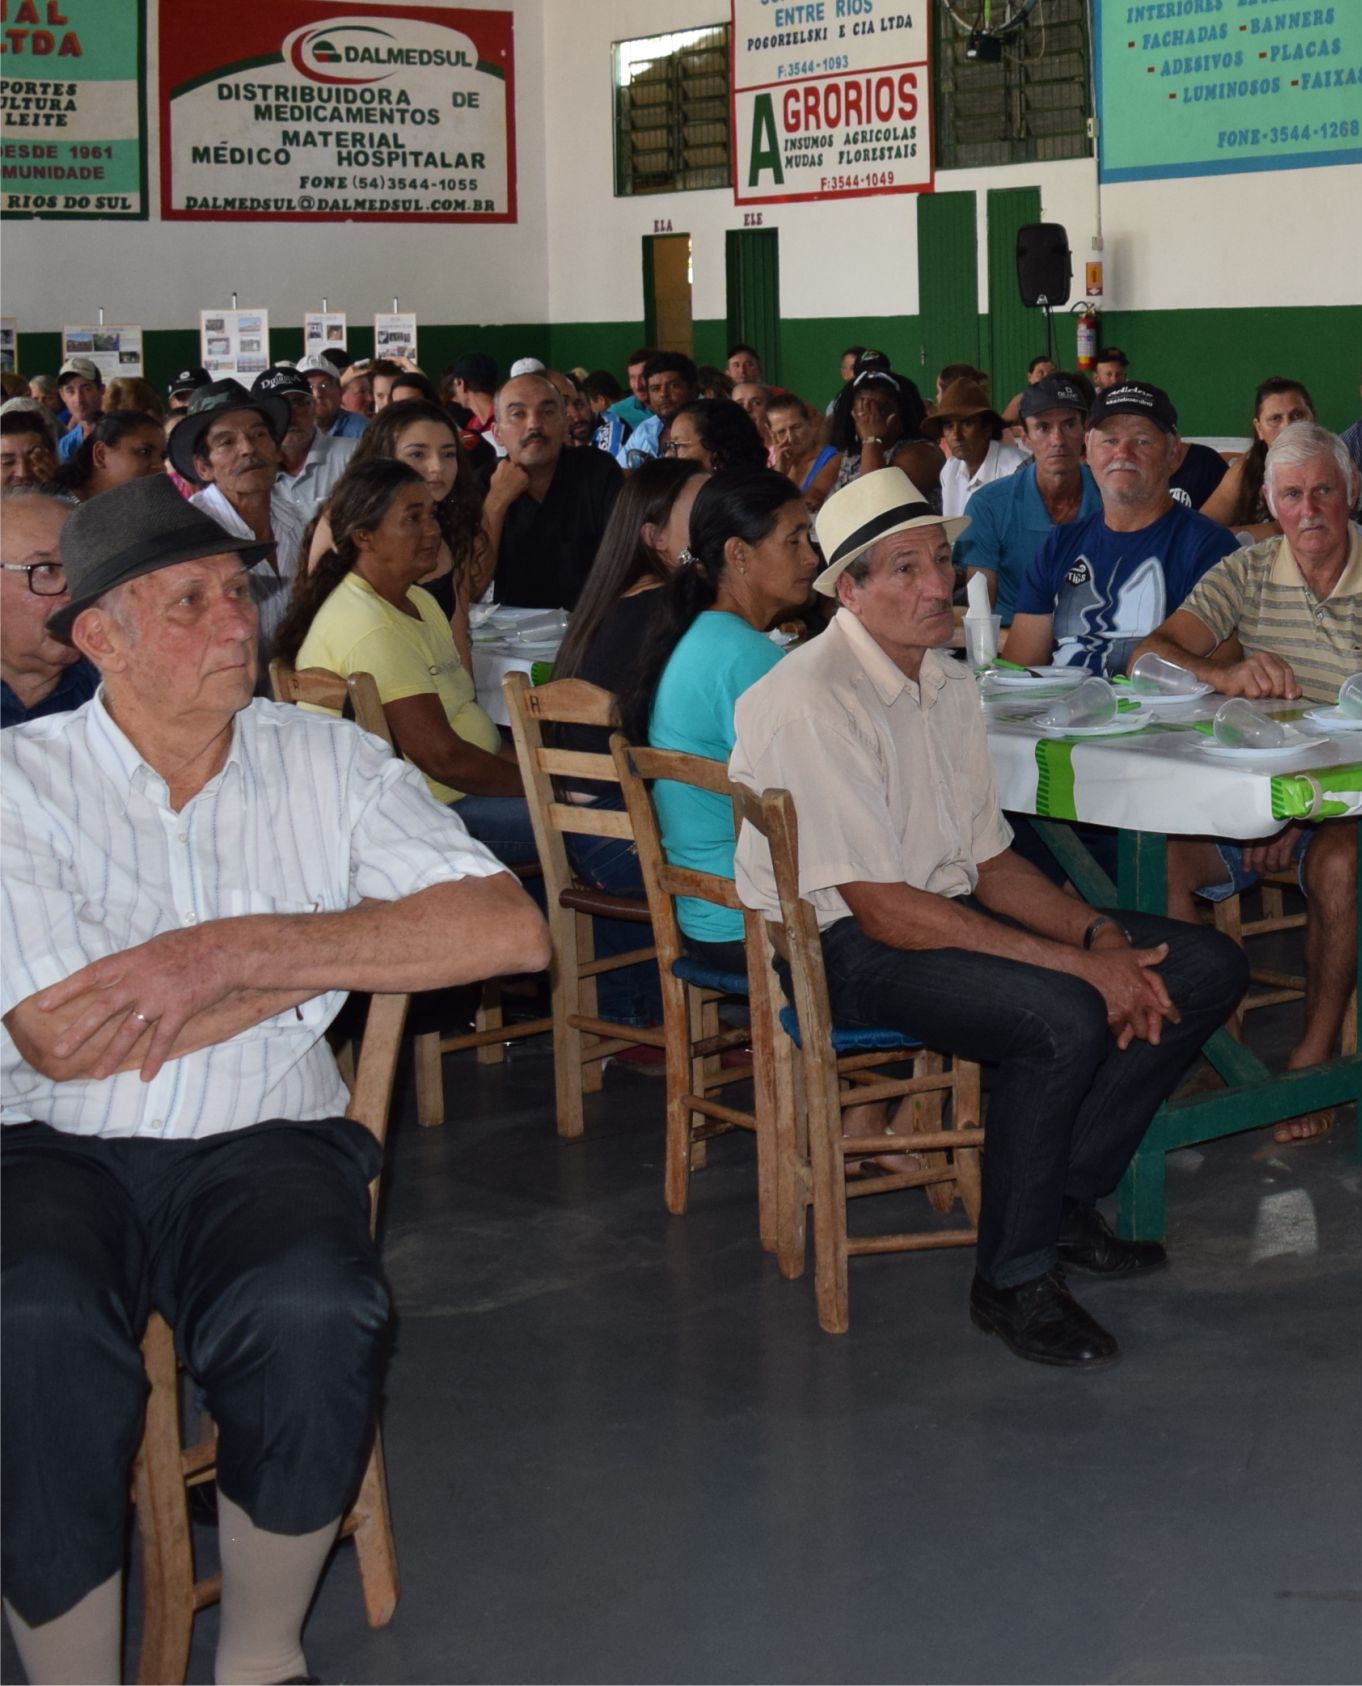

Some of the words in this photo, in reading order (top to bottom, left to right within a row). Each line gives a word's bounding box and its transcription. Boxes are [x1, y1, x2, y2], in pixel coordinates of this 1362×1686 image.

[775, 3, 825, 28] ENTRE
[836, 0, 873, 18] RIOS
[1126, 0, 1224, 24] INTERIORES
[747, 28, 828, 51] POGORZELSKI
[838, 25, 846, 38] E
[853, 20, 875, 36] CIA
[880, 14, 913, 31] LTDA
[1141, 23, 1228, 50] FACHADAS
[1250, 8, 1336, 35] BANNERS
[345, 45, 473, 68] DALMEDSUL
[777, 54, 849, 79] F:3544-1093
[1160, 51, 1243, 77] ADESIVOS
[1269, 38, 1341, 62] PLACAS
[217, 83, 411, 106] DISTRIBUIDORA
[452, 91, 480, 109] DE
[1182, 77, 1281, 103] LUMINOSOS
[5, 113, 68, 127] LEITE
[254, 104, 441, 126] MEDICAMENTOS
[281, 130, 405, 149] MATERIAL
[784, 134, 834, 152] INSUMOS
[844, 126, 917, 146] AGRICOLAS
[1, 145, 58, 159] ESDE
[70, 146, 112, 159] 1961
[191, 141, 292, 165] MÉDICO
[336, 151, 486, 170] HOSPITALAR
[785, 155, 824, 169] MUDAS
[838, 144, 917, 165] FLORESTAIS
[299, 176, 348, 190] FONE
[351, 176, 478, 192] (54)3544-1055
[820, 173, 895, 191] F:3544-1049
[7, 195, 58, 208] RIOS
[63, 197, 91, 209] DO
[94, 197, 132, 210] SUL
[653, 219, 673, 233] ELA
[743, 213, 763, 227] ELE
